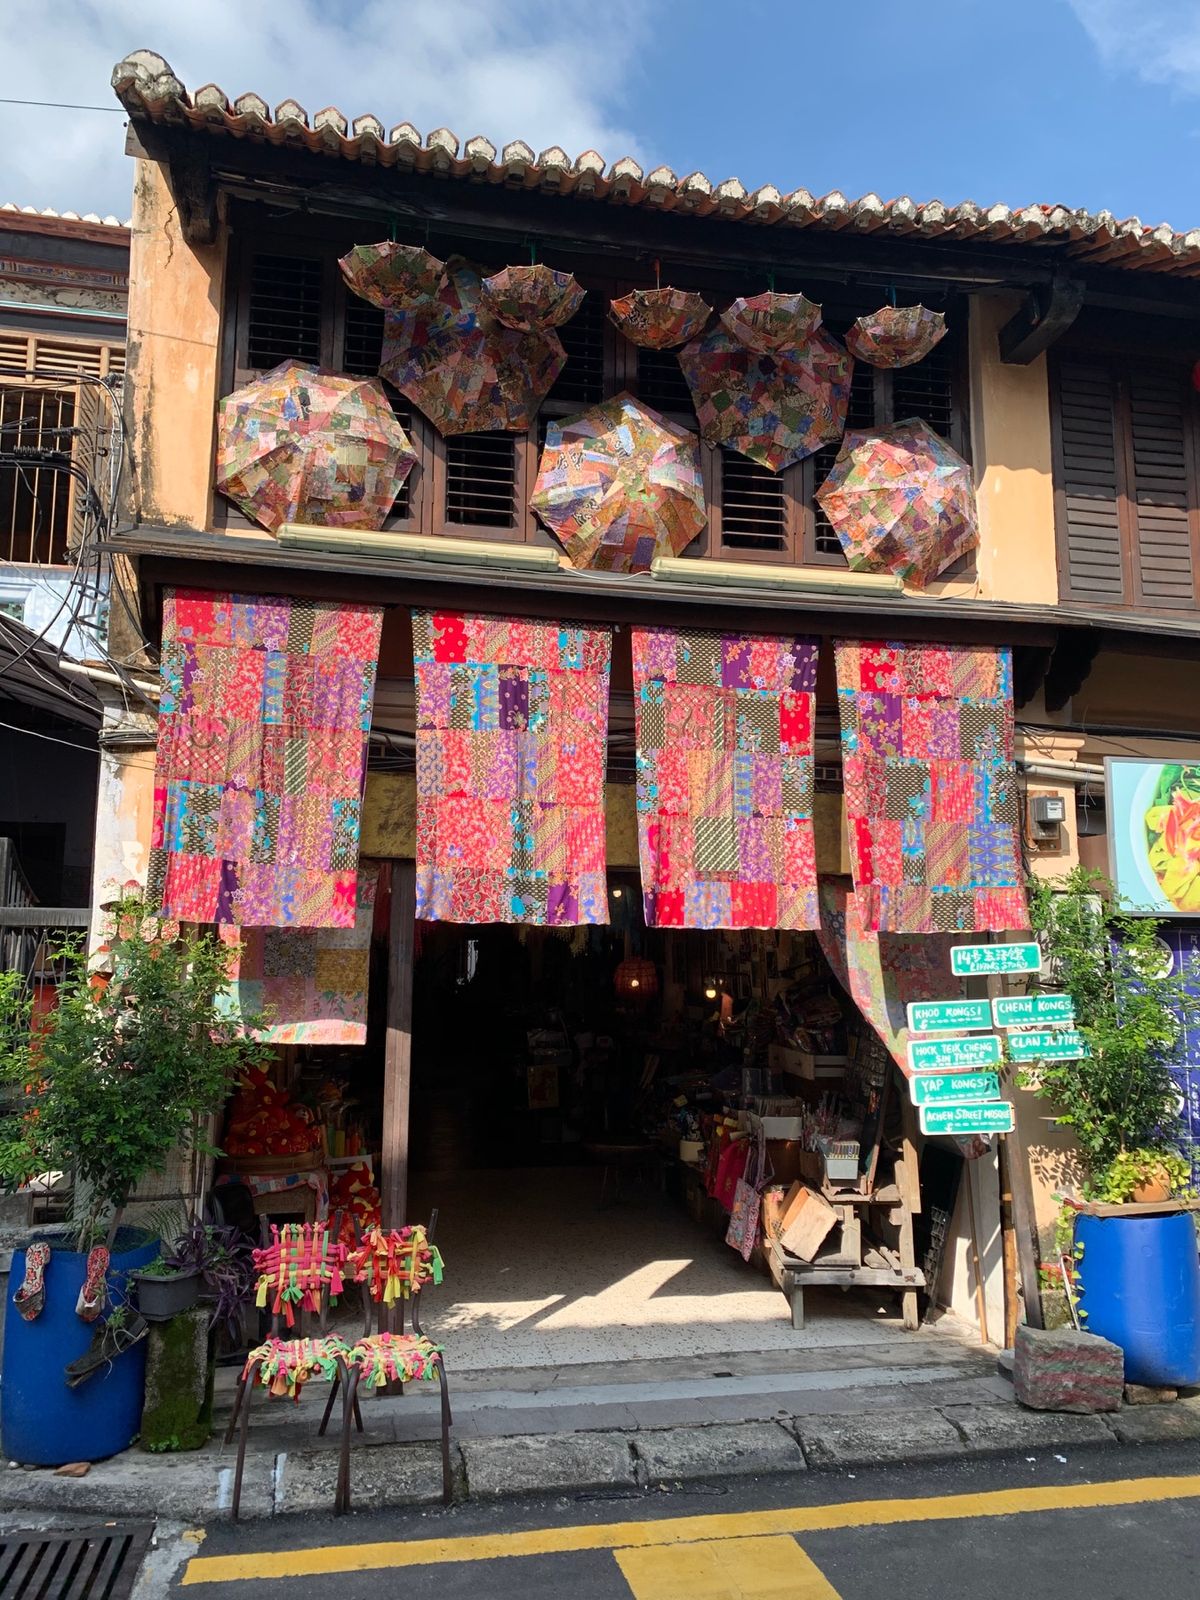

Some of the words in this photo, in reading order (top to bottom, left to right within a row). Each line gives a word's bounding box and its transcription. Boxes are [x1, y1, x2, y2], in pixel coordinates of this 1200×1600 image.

[915, 1008, 940, 1019] KHOO
[945, 1006, 981, 1017] KONGSI
[999, 1001, 1032, 1013] CHEAH
[1011, 1036, 1041, 1048] CLAN
[915, 1046, 938, 1056] HOCK
[941, 1043, 961, 1053] TEIK
[963, 1042, 992, 1053] CHENG
[954, 1051, 985, 1062] TEMPLE
[921, 1079, 944, 1093] YAP
[951, 1078, 987, 1090] KONGSI
[927, 1111, 953, 1122] ACHEH
[955, 1108, 982, 1120] STREET
[983, 1109, 1010, 1119] MOSQUE
